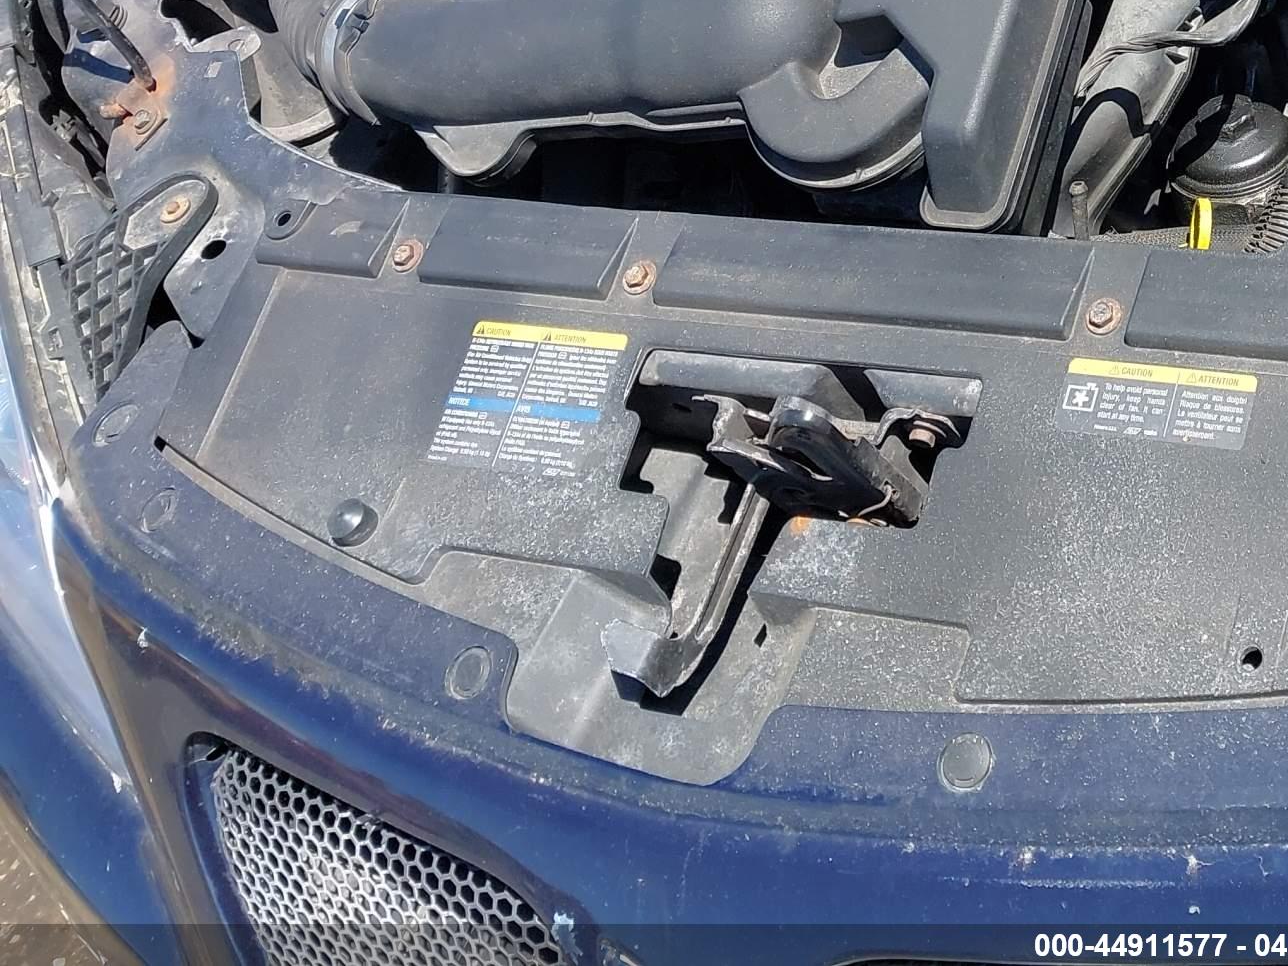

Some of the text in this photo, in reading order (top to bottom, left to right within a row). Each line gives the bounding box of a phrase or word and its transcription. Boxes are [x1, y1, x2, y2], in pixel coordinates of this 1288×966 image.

[1121, 367, 1153, 378] CAUTION
[1197, 375, 1240, 386] ATTENTION
[1113, 384, 1126, 393] help
[1126, 385, 1142, 394] avoid
[1118, 403, 1125, 411] of
